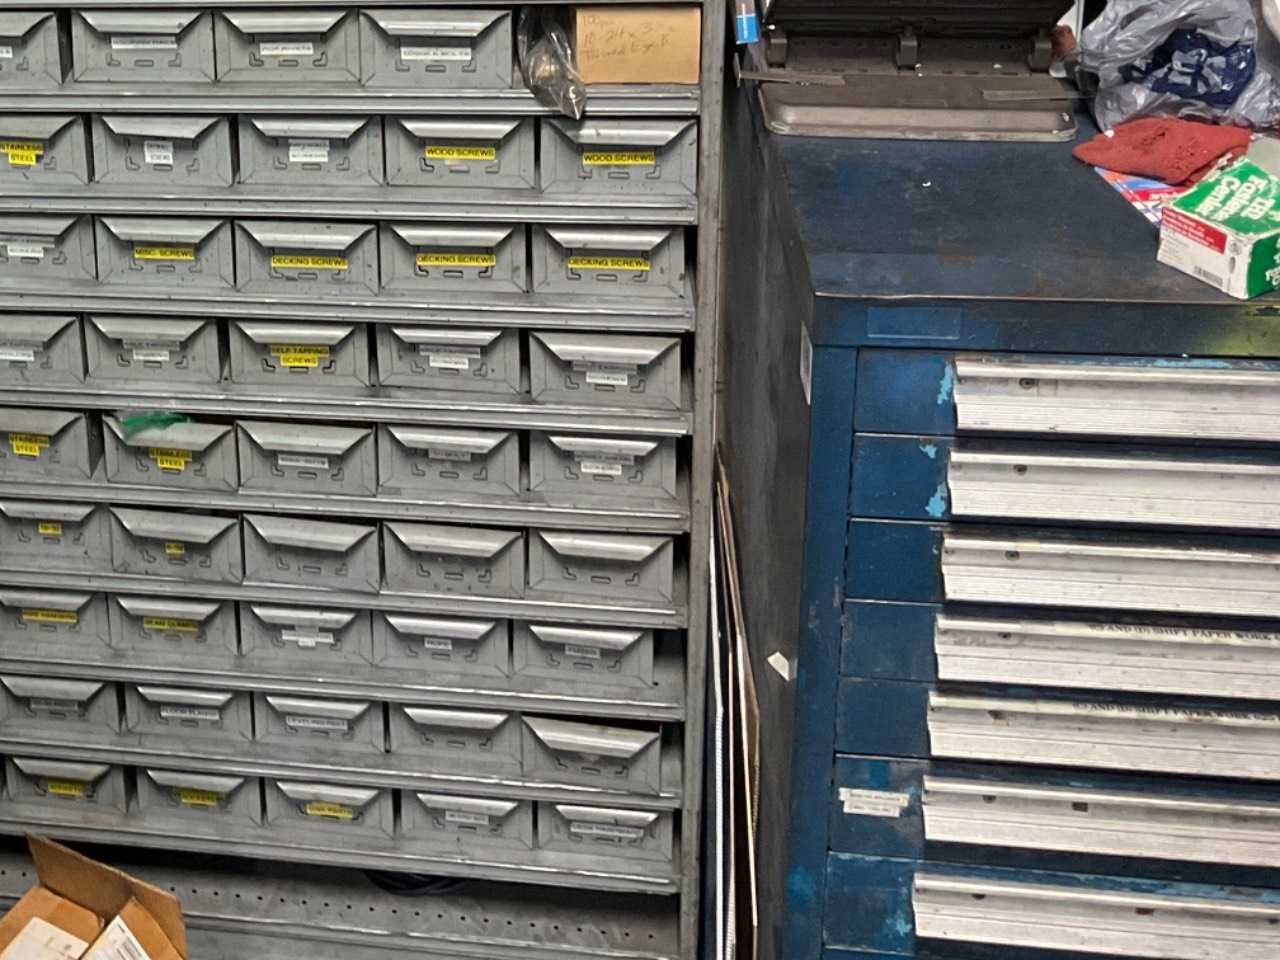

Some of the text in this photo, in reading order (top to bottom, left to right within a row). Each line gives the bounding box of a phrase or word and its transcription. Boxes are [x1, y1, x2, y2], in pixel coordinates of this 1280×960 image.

[426, 147, 494, 157] WOOD SCREWS
[584, 153, 654, 163] WOOD SCREWS
[159, 249, 194, 258] SCREWS
[273, 256, 347, 267] DECKING SCREWS
[416, 255, 495, 264] DECKING SCREWS
[569, 257, 650, 269] DECKING SCREWS
